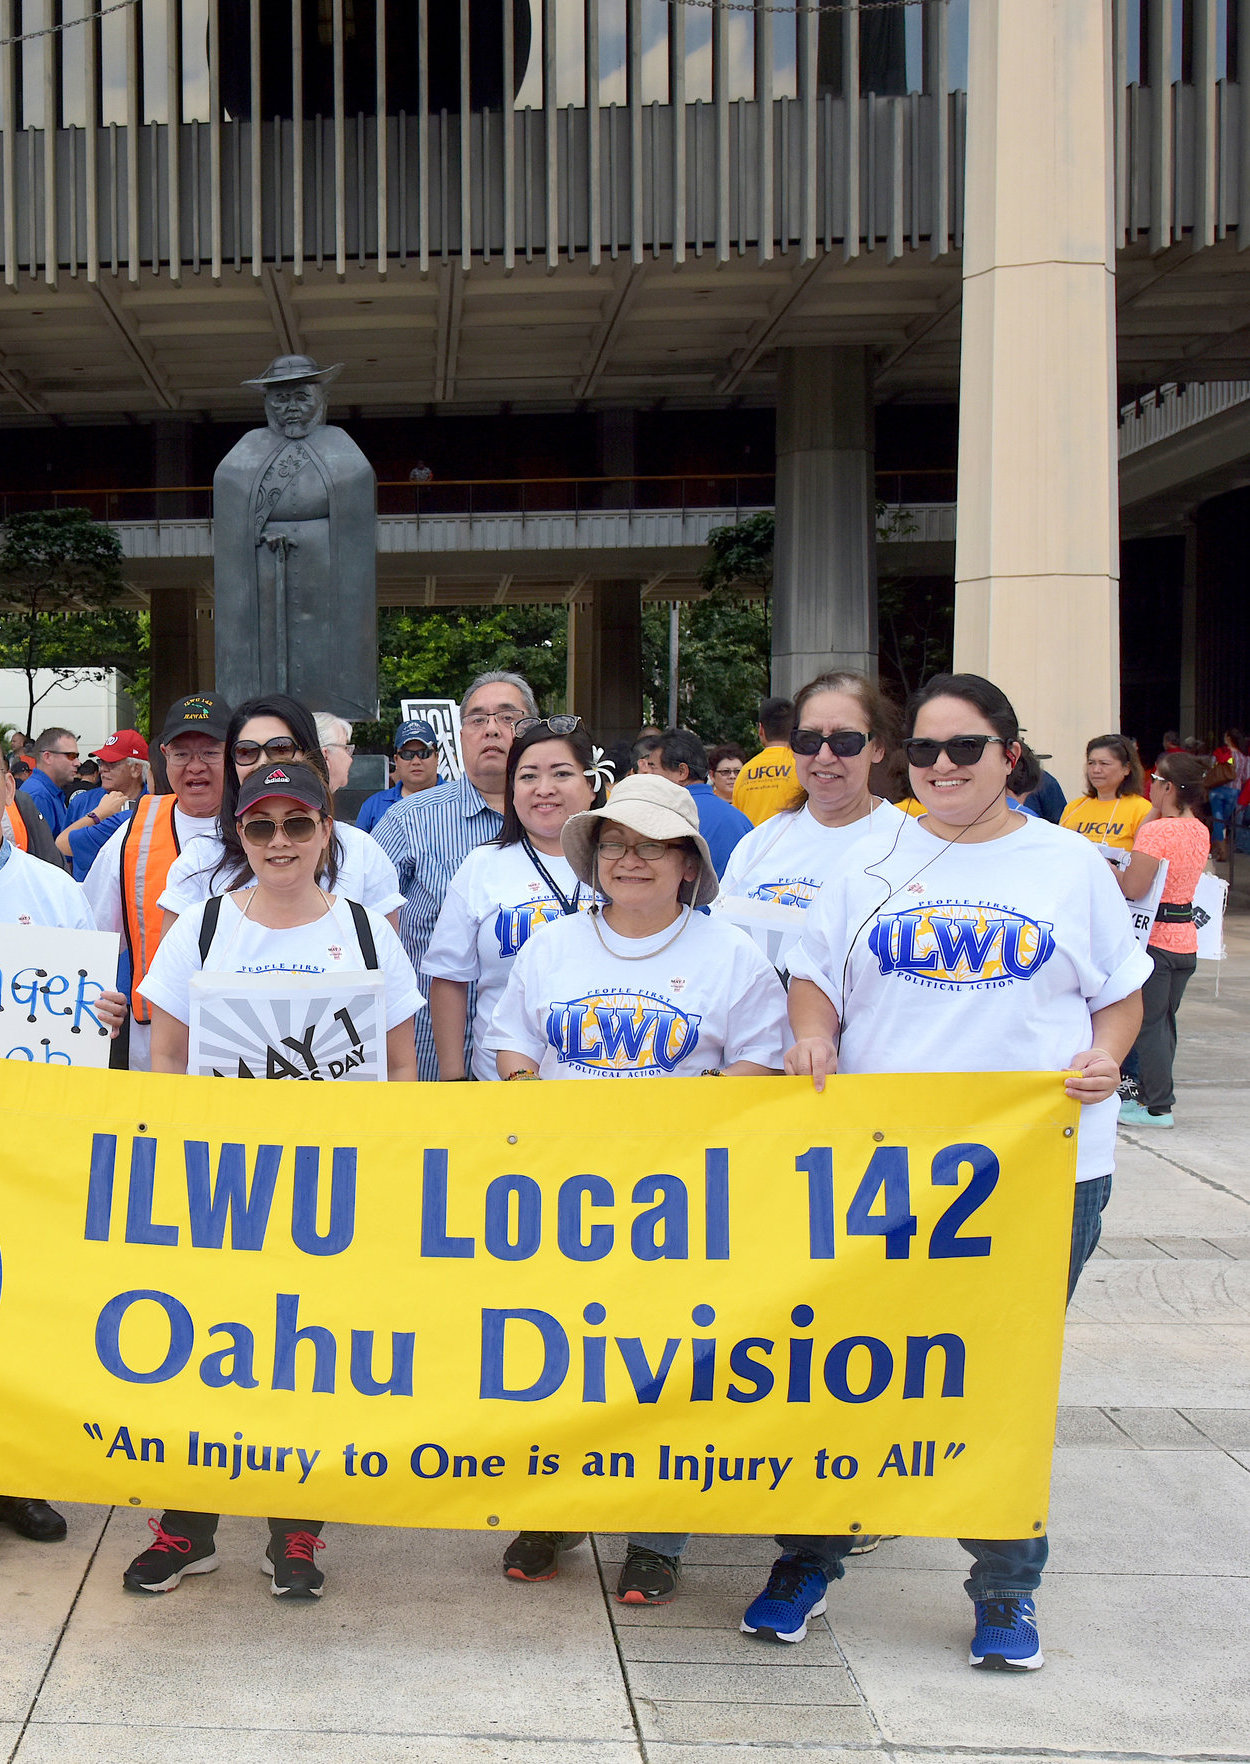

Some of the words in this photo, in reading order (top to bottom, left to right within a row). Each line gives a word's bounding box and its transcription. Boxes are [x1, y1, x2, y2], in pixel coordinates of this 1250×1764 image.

[748, 765, 791, 779] UFCW
[1077, 822, 1124, 836] UFCW
[919, 899, 970, 907] PEOPLE
[978, 900, 1017, 912] FIRST
[876, 914, 1054, 981] ILWU
[242, 963, 285, 972] PEOPLE
[293, 964, 327, 973] FIRST
[896, 971, 962, 992] POLITICAL
[968, 978, 1014, 991] ACTION
[587, 988, 631, 996] PEOPLE
[638, 989, 671, 1003] FIRST
[333, 1007, 361, 1047] 1
[550, 1001, 702, 1072] ILWU
[328, 1044, 365, 1079] DAY
[568, 1063, 622, 1078] POLITICAL
[628, 1069, 662, 1078] ACTION
[84, 1133, 358, 1257] ILWU
[420, 1147, 730, 1261] Local
[794, 1142, 1000, 1260] 142
[94, 1289, 416, 1397] Oahu
[479, 1302, 967, 1404] Division
[188, 1430, 321, 1484] Injury
[343, 1443, 389, 1478] to
[410, 1443, 506, 1479] One
[528, 1445, 560, 1477] is
[581, 1449, 635, 1478] an
[658, 1444, 793, 1493] Injury
[815, 1449, 859, 1480] to
